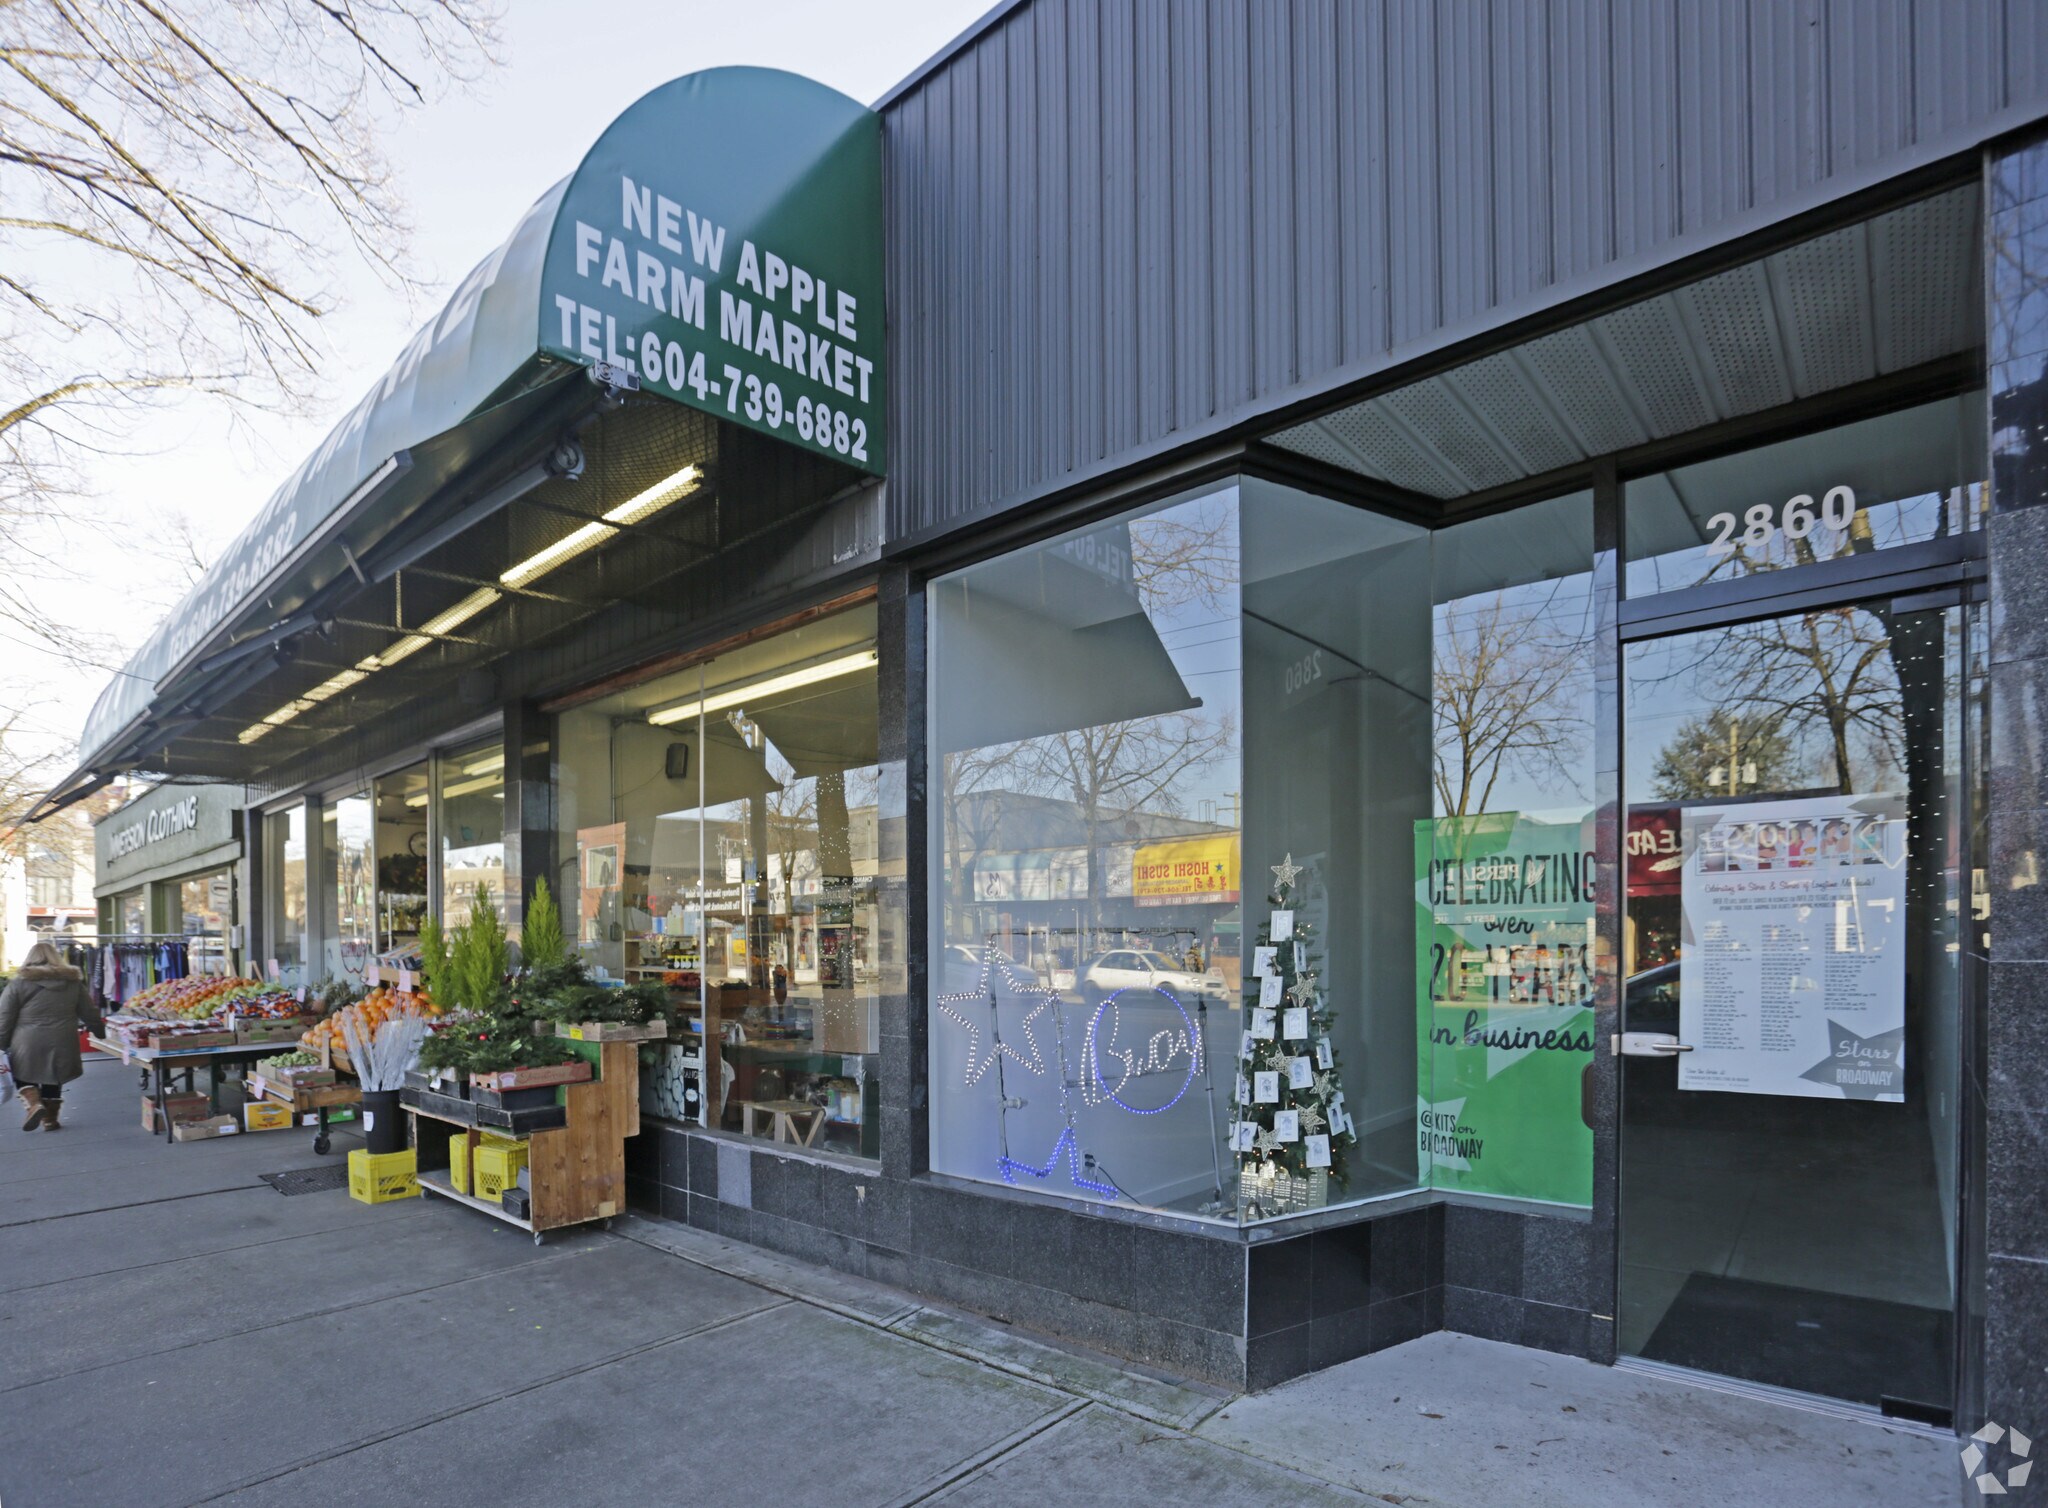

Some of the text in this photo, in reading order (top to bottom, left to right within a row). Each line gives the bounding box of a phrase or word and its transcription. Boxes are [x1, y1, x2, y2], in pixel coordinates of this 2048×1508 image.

[622, 175, 857, 342] NEW APPLE
[576, 220, 873, 403] FARM MARKET
[1706, 485, 1856, 557] 2860
[1428, 852, 1596, 906] CELEBRATING
[1484, 915, 1534, 934] over
[1486, 943, 1595, 1007] YEARS
[1464, 1009, 1595, 1052] business
[1835, 1040, 1893, 1059] Stars
[1836, 1068, 1893, 1086] BROADWAY
[1420, 1136, 1483, 1160] BROADWAY
